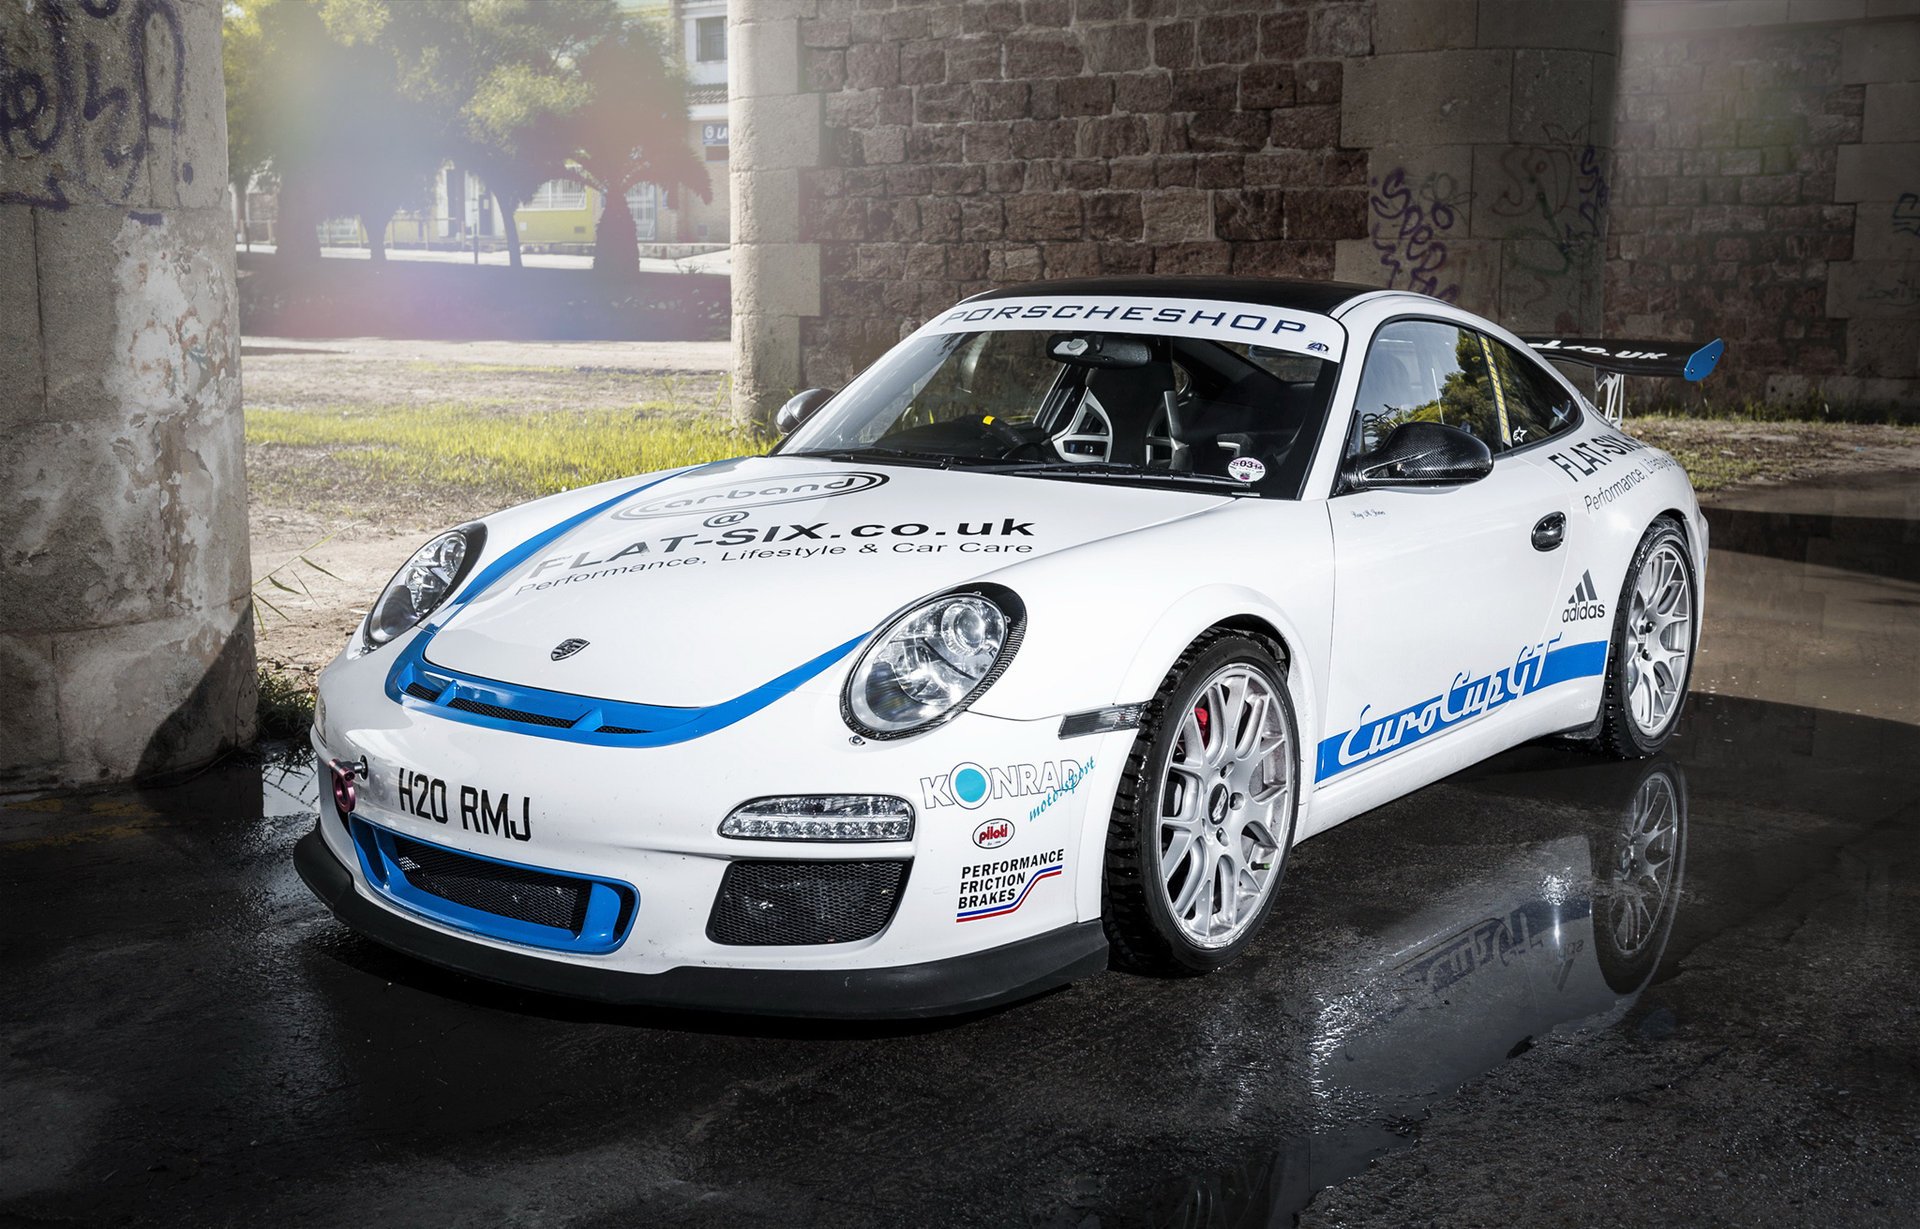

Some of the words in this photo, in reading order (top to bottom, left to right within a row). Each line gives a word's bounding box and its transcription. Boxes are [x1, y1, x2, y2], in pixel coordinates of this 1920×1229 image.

[940, 305, 1306, 335] PORSCHESHOP
[1240, 459, 1253, 468] 03
[638, 477, 855, 512] carband
[1584, 468, 1649, 515] Performance,
[702, 511, 750, 528] @
[528, 518, 1036, 579] FLAT-SIX.co.uk
[514, 555, 707, 597] Performance,
[721, 545, 846, 561] Lifestyle
[859, 543, 878, 554] &
[892, 542, 948, 553] Car
[959, 542, 1033, 553] Care
[1562, 601, 1606, 623] adidas
[920, 759, 1082, 810] KONRAD
[460, 785, 532, 842] RMJ
[979, 823, 1008, 844] piloti
[961, 849, 1065, 879] PERFORMANCE
[960, 872, 1026, 895] FRICTION
[958, 888, 1017, 910] BRAKES
